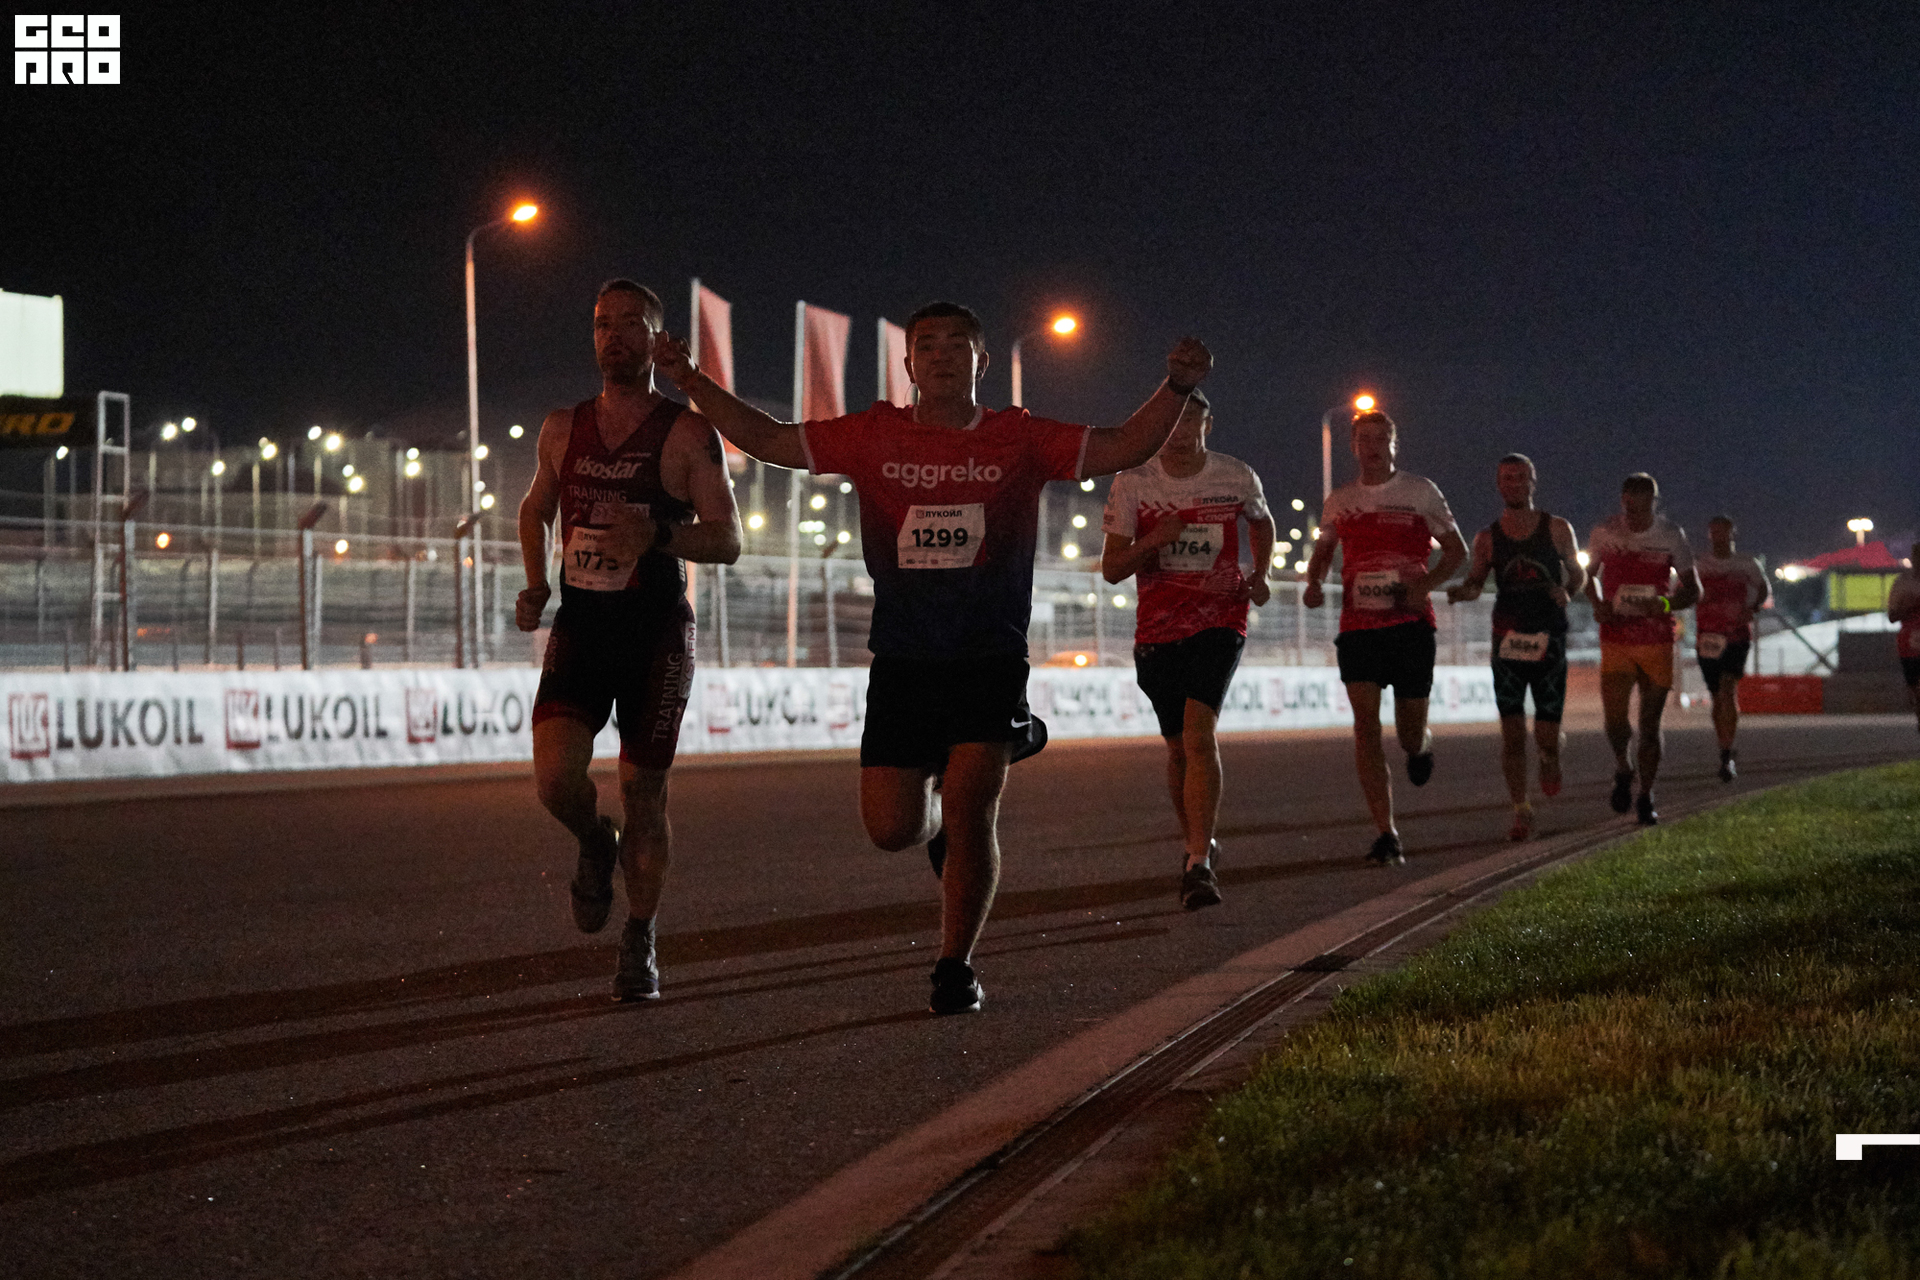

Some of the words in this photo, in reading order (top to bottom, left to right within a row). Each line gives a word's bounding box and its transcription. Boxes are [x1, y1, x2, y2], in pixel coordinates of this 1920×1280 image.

[0, 412, 76, 435] RO
[574, 456, 643, 479] isostar
[882, 457, 1002, 489] aggreko
[568, 485, 627, 502] TRAINING
[925, 509, 962, 518] ЛУКОЙЛ
[912, 528, 968, 547] 1299
[1171, 541, 1211, 555] 1764
[651, 652, 683, 742] TRAINING
[57, 696, 203, 749] LUKOIL
[266, 694, 388, 740] LUKOIL
